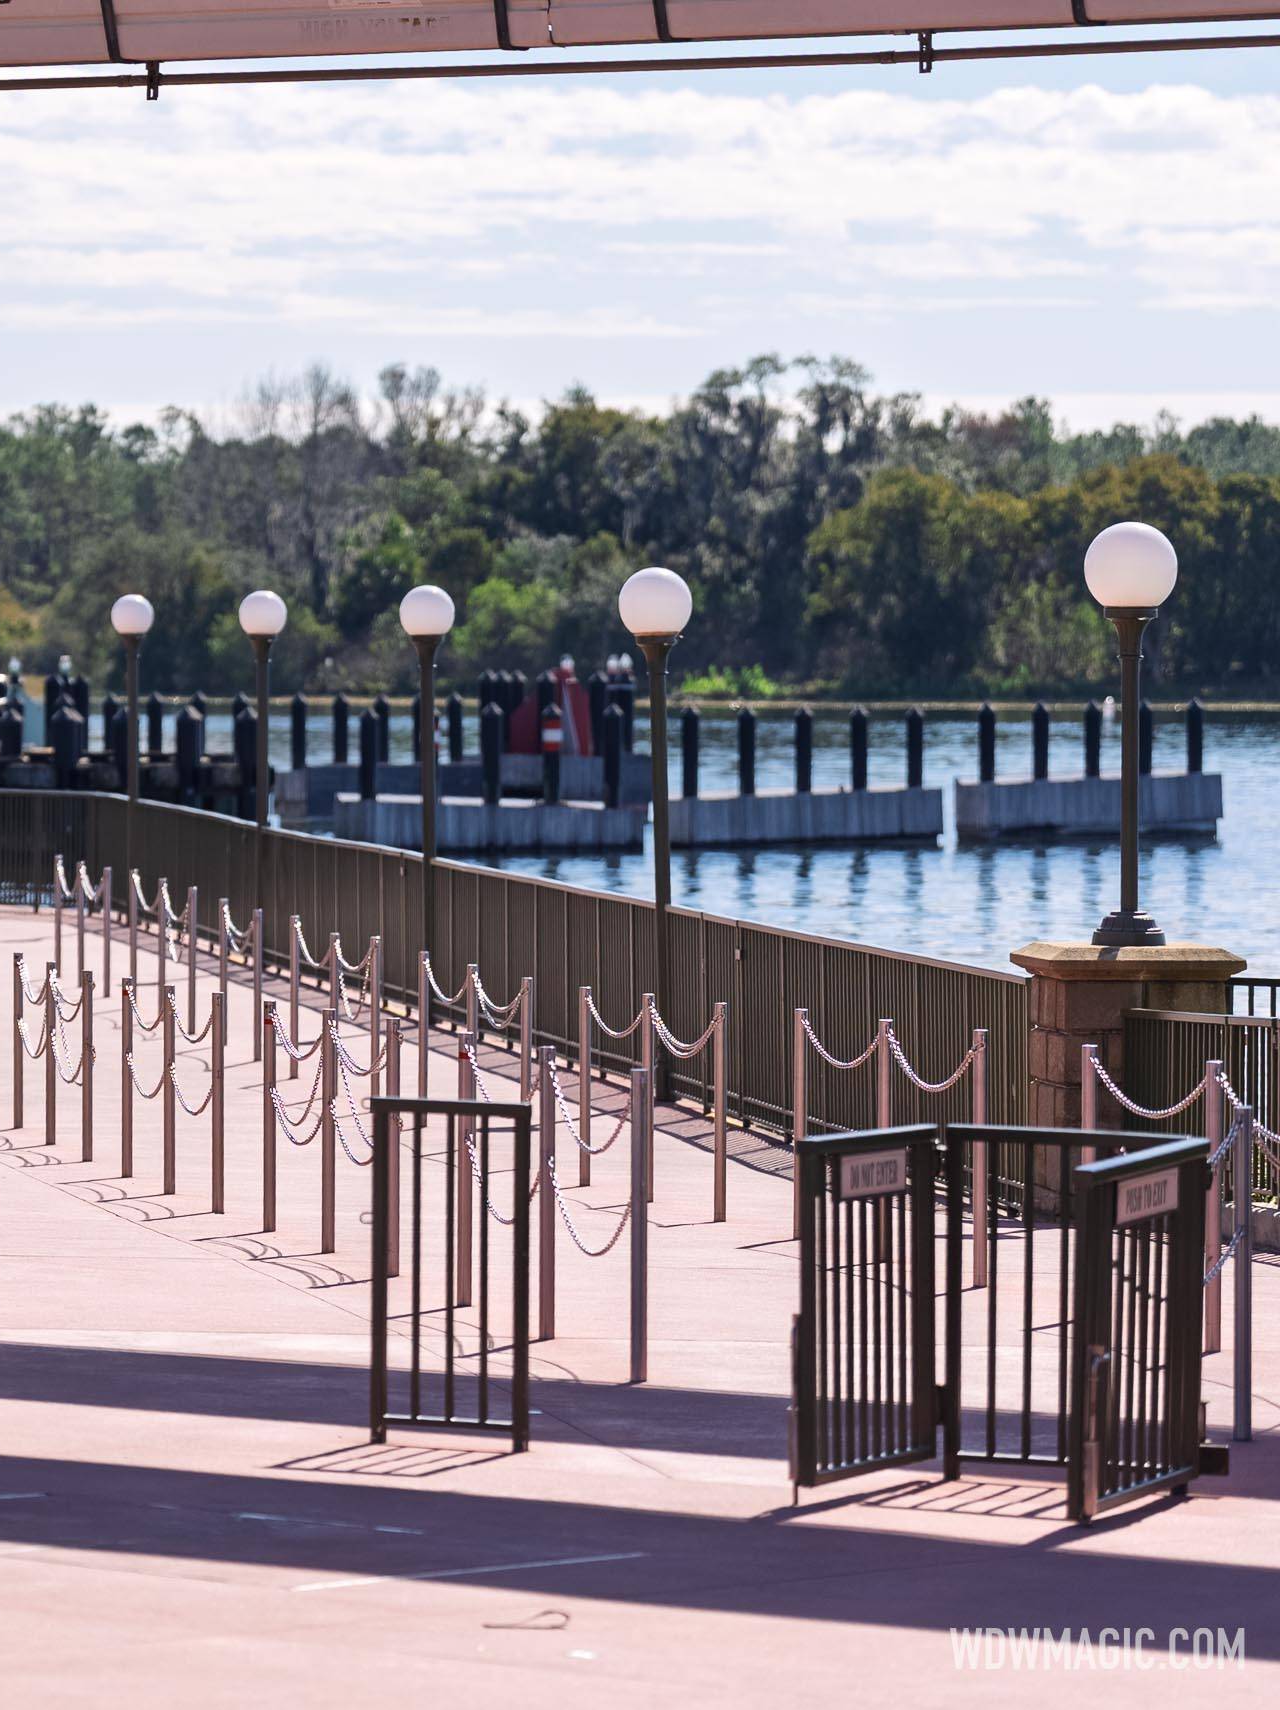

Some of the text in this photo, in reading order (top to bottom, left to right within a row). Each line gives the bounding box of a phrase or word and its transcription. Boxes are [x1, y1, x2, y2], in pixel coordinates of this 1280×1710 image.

[850, 1159, 898, 1190] DO NOT ENTER
[1125, 1179, 1168, 1215] PUSH TO EXIT
